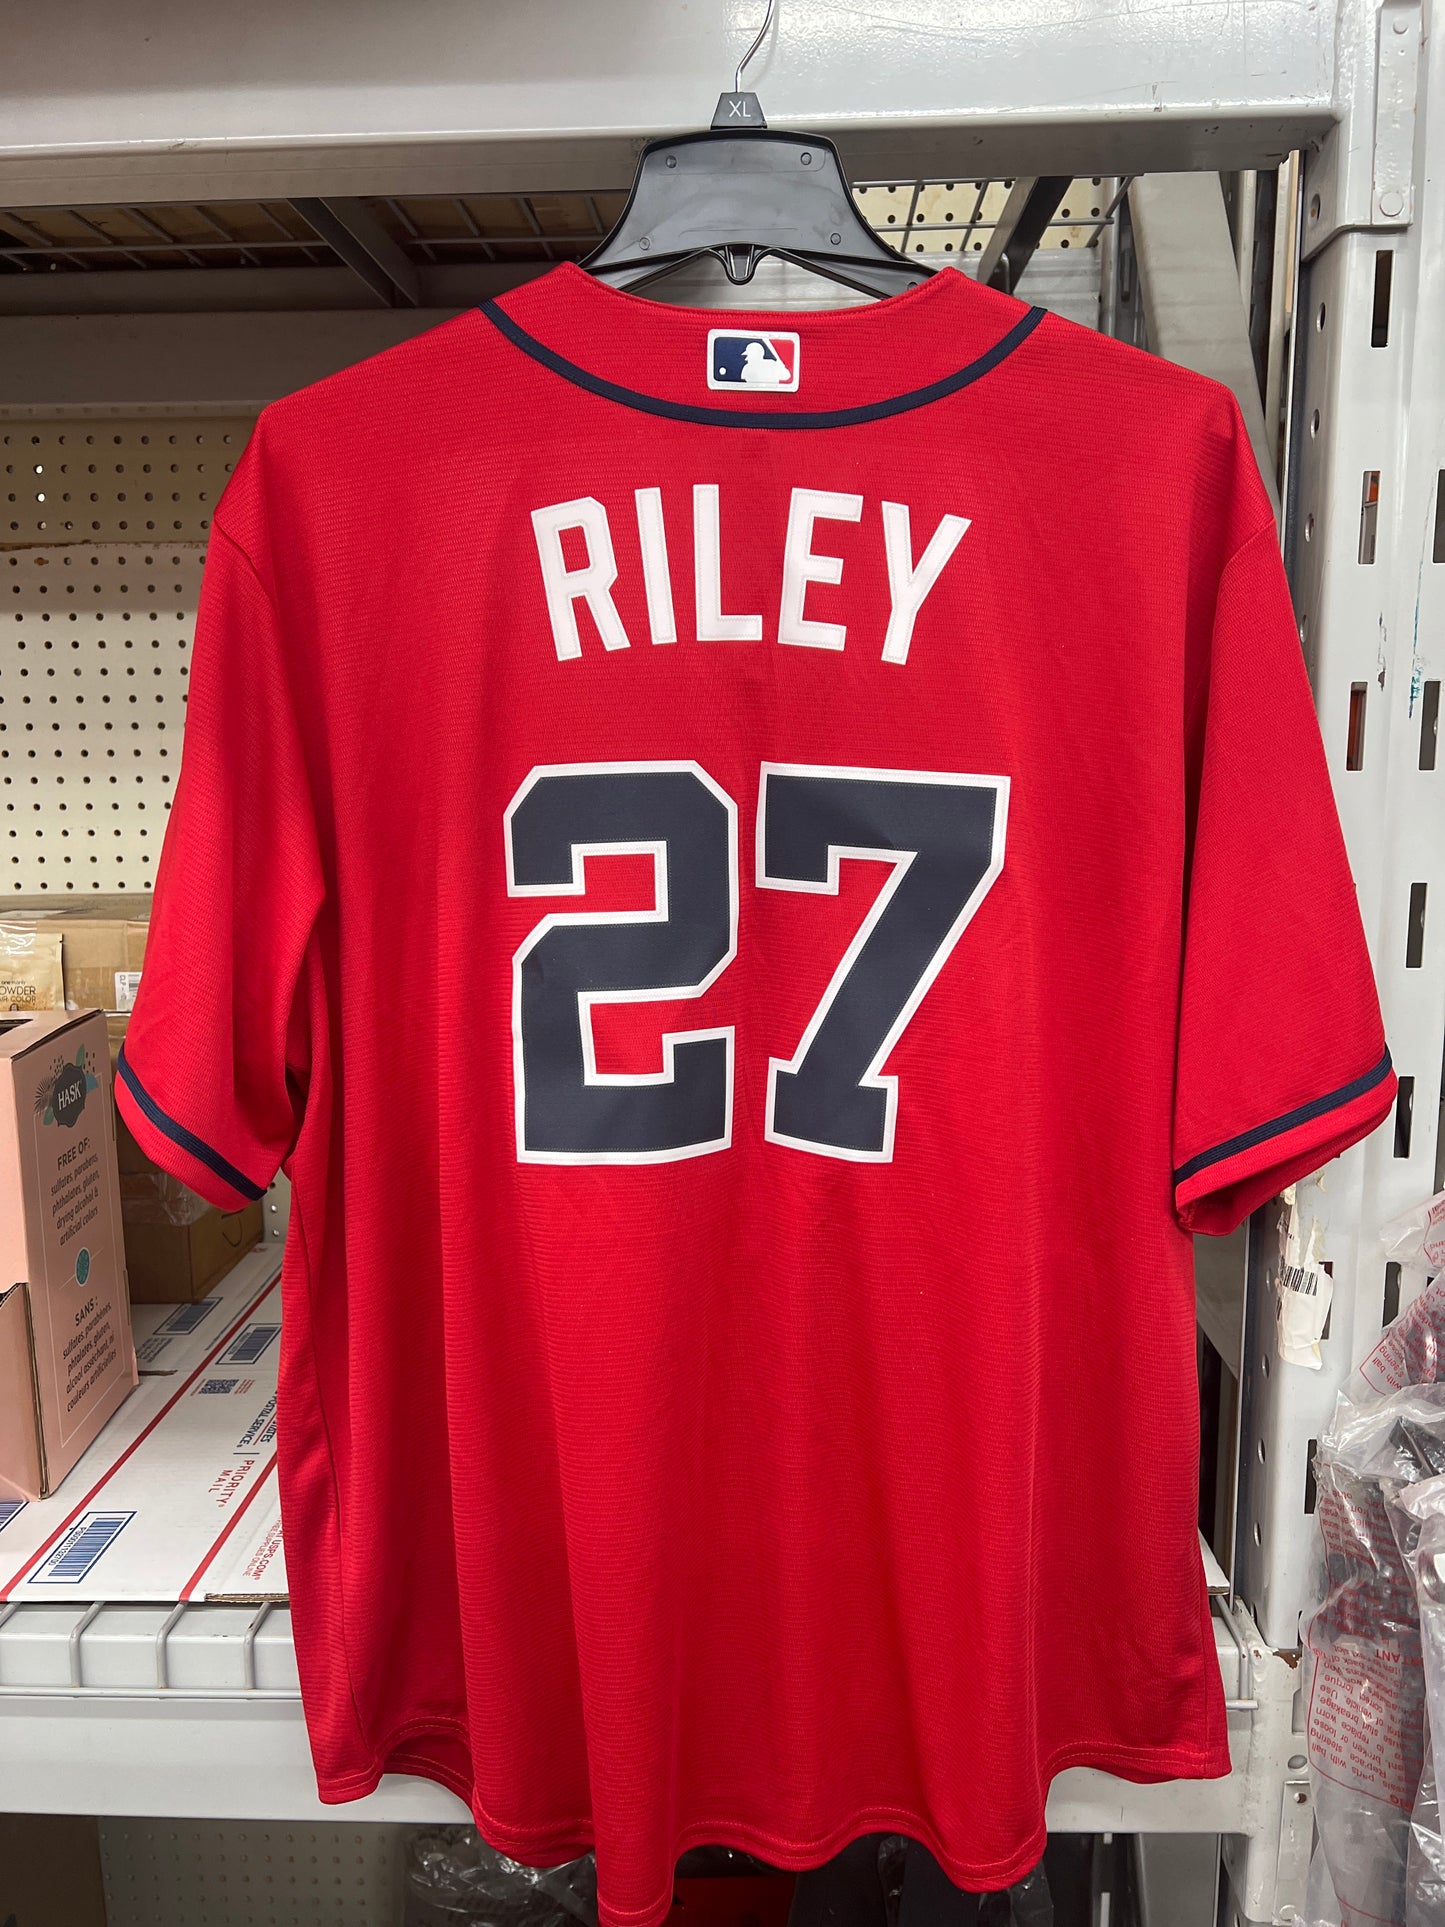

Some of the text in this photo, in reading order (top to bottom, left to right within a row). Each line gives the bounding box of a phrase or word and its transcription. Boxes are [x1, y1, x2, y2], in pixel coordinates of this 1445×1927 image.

[728, 100, 751, 118] XL
[530, 484, 972, 665] RILEY
[503, 759, 1011, 1166] 27
[0, 985, 36, 996] OWDER
[10, 995, 37, 1003] COLOR
[57, 1080, 82, 1111] HASK
[57, 1136, 90, 1171] FREE OF:
[56, 1208, 74, 1230] drying
[74, 1188, 94, 1216] alcohol
[59, 1205, 99, 1247] artificial colors
[1371, 1356, 1386, 1374] ball
[66, 1367, 83, 1394] alcool
[67, 1379, 90, 1412] couleurs
[208, 1469, 233, 1494] MAIL
[1320, 1684, 1338, 1699] Use
[1316, 1707, 1337, 1723] worn
[1313, 1718, 1337, 1738] loose
[1340, 1734, 1349, 1744] or
[1341, 1721, 1369, 1744] replace
[1310, 1727, 1343, 1753] steering
[1311, 1742, 1327, 1758] ball
[1330, 1753, 1347, 1769] with
